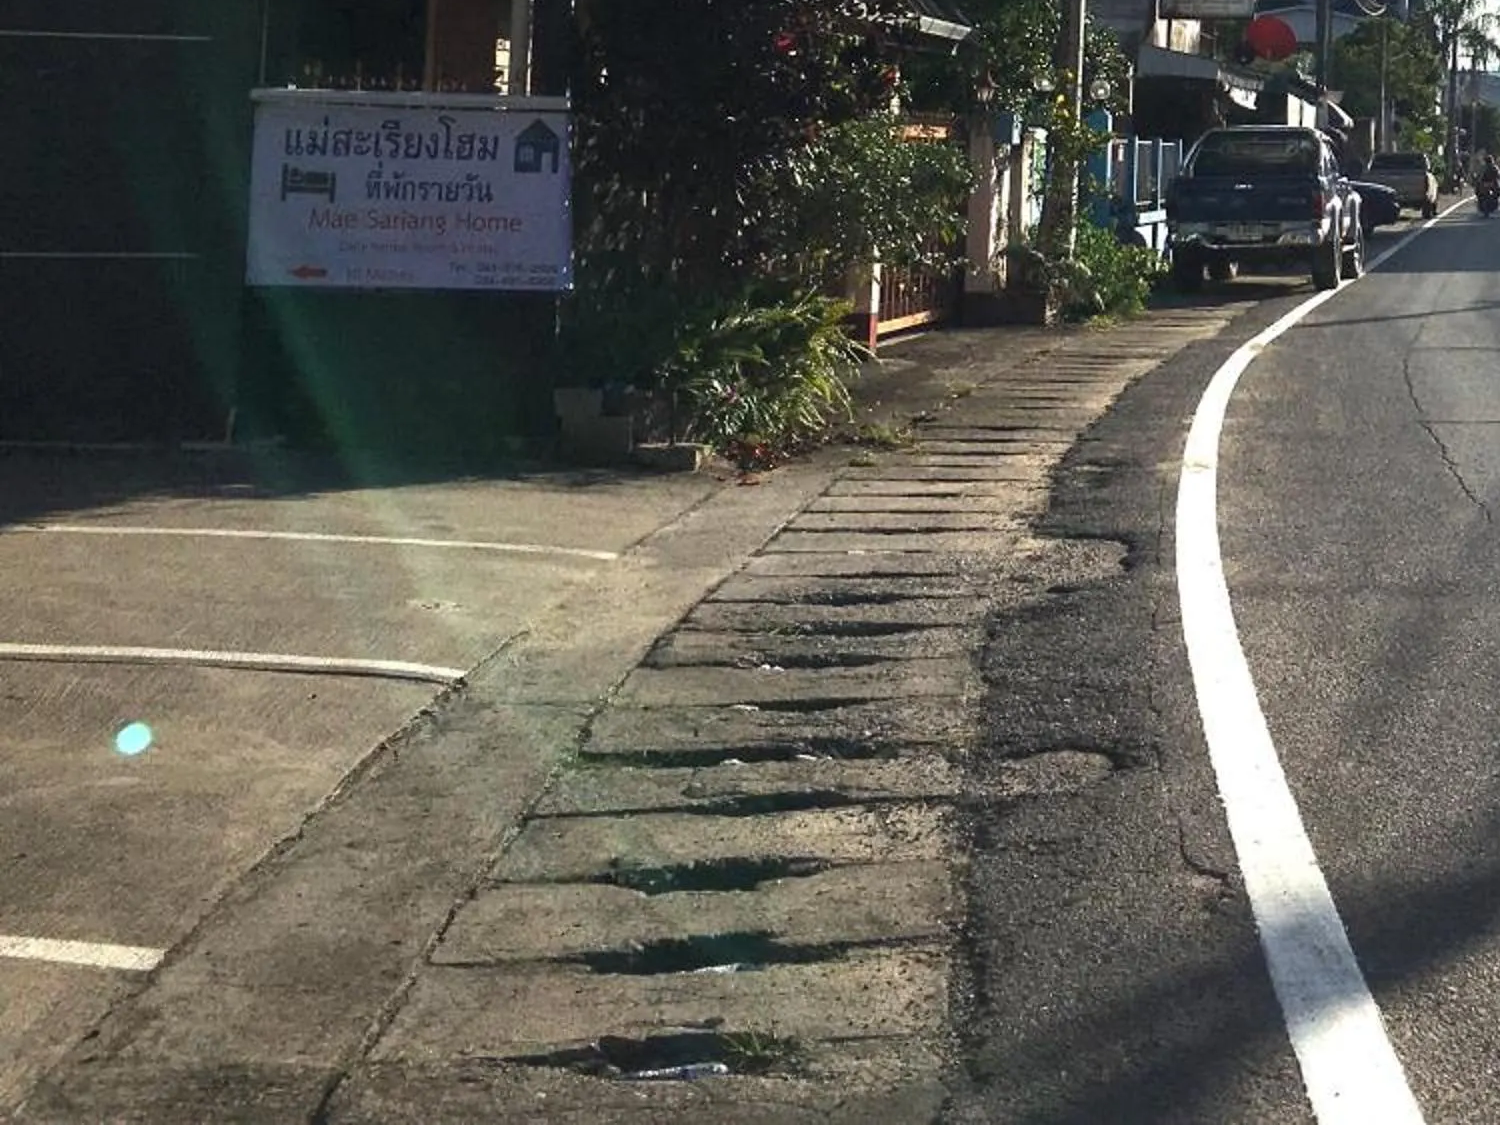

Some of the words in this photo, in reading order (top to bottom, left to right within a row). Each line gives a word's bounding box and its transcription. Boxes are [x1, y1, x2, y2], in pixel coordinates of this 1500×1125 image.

[284, 116, 498, 162] แม่สะเรียงโฮม
[365, 163, 493, 203] ที่พักรายวัน
[308, 209, 357, 230] Mae
[368, 210, 447, 236] Sariang
[457, 212, 522, 233] Home
